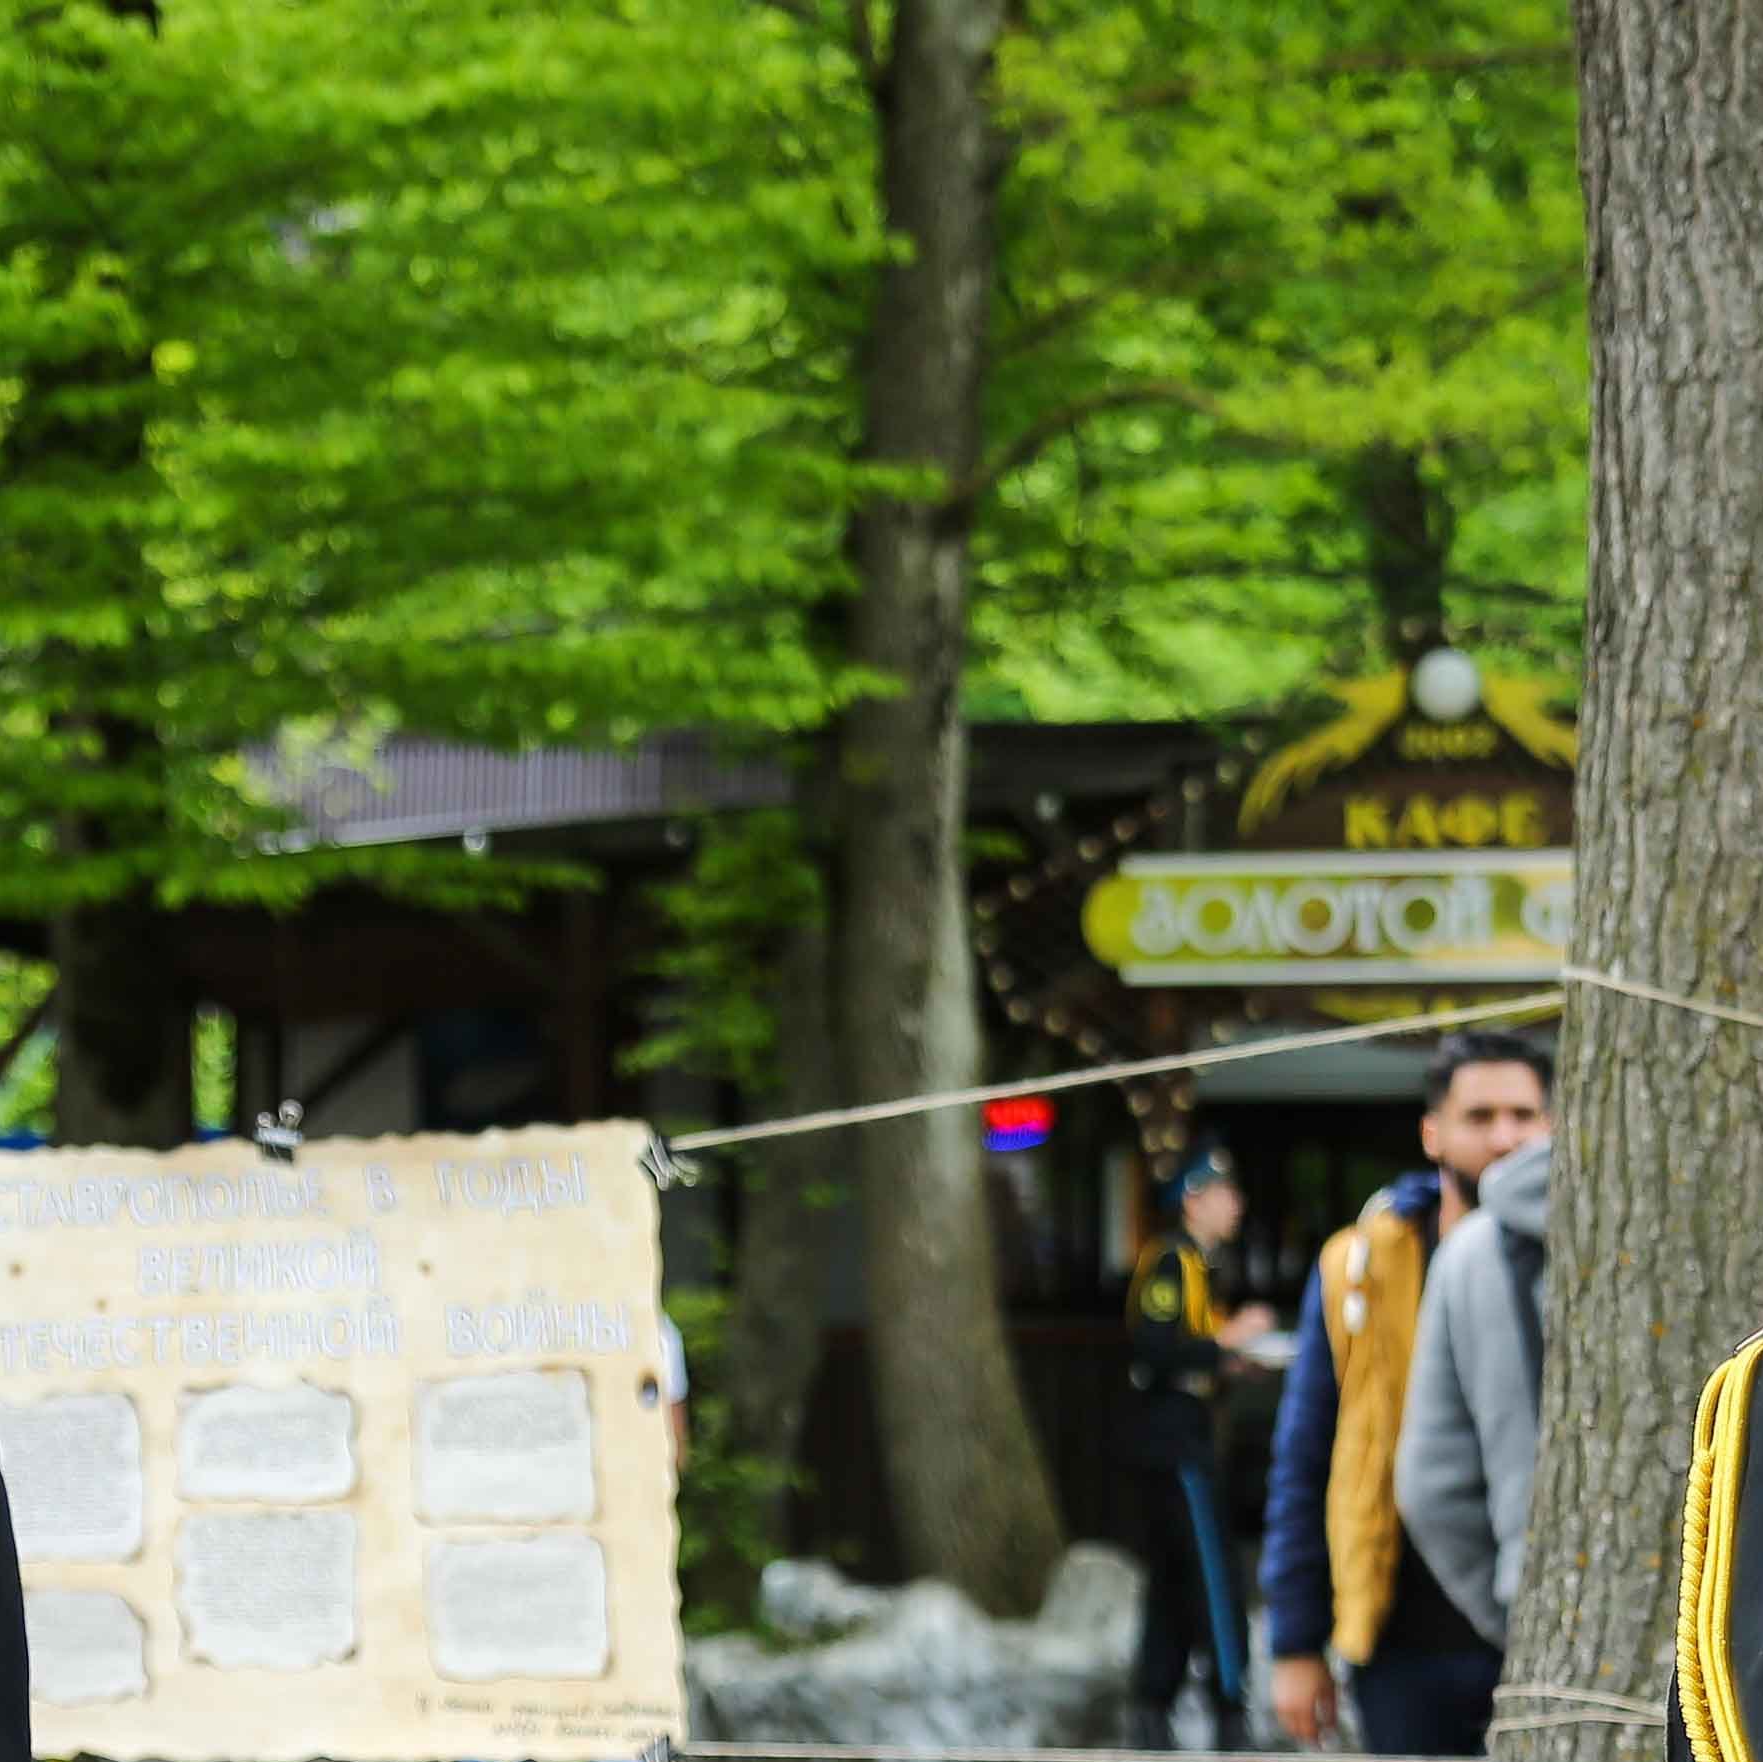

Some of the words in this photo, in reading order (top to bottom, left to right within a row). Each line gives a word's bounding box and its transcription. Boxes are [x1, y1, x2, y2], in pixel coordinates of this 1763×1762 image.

[1343, 795, 1543, 849] КАФЕ
[364, 1162, 397, 1212] В
[434, 1152, 590, 1216] ГОДЫ
[139, 1227, 378, 1296] ВЕЛИКОЙ
[445, 1287, 629, 1357] ВОЙНЫ
